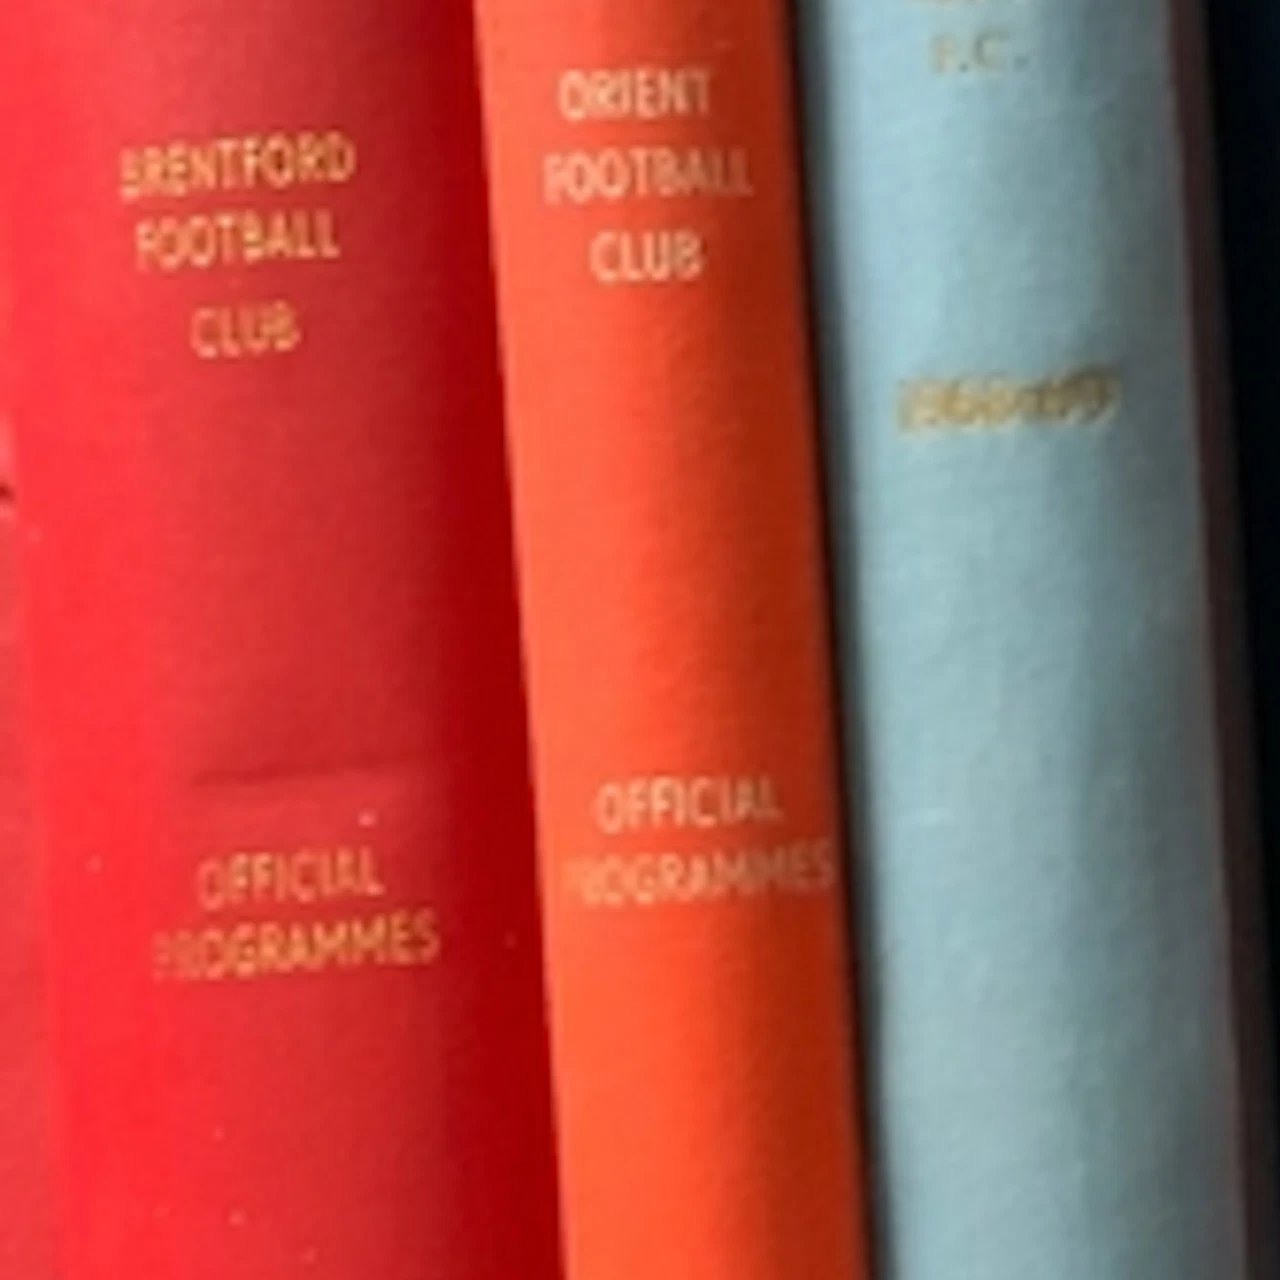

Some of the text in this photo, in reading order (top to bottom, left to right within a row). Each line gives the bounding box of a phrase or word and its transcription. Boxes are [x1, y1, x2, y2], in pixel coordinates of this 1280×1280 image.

[556, 69, 714, 120] ORIENT
[120, 131, 356, 200] BRENTFORD
[541, 145, 754, 206] FOOTBALL
[136, 199, 342, 271] FOOTBALL
[588, 230, 705, 284] CLUB
[189, 302, 302, 359] CLUB
[592, 774, 785, 835] OFFICIAL
[195, 844, 387, 910] OFFICIAL
[150, 907, 442, 982] PROGRAMMES
